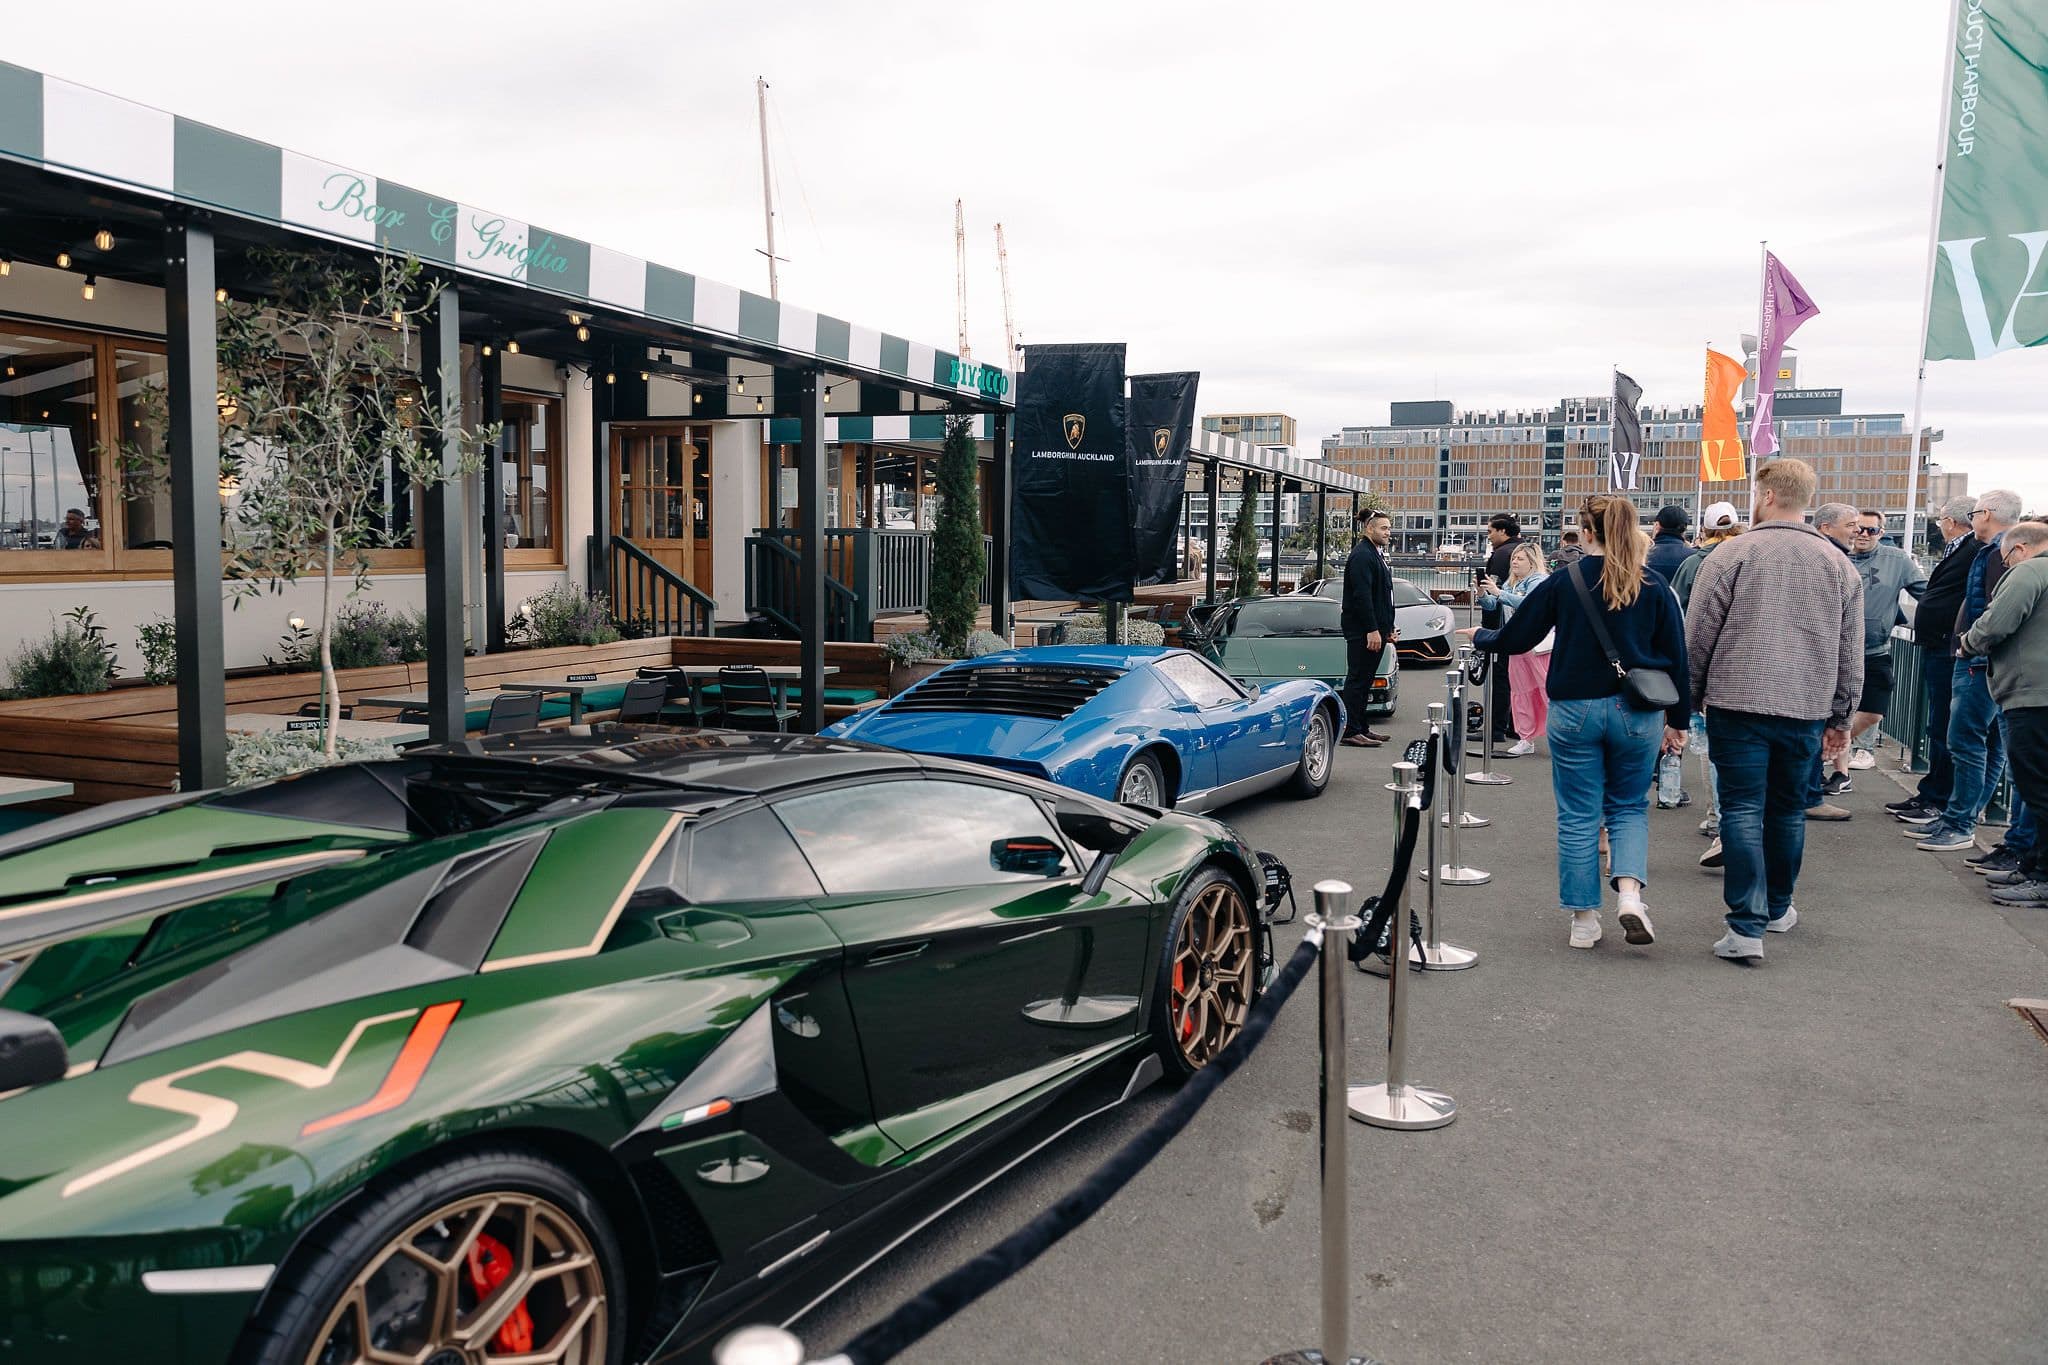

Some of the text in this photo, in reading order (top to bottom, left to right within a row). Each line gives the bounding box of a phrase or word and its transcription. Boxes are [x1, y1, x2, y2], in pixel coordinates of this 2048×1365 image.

[1957, 54, 1981, 157] HARBOUR
[318, 173, 405, 228] Bar
[467, 214, 568, 278] Griglia
[1077, 452, 1115, 462] AUCKLAND
